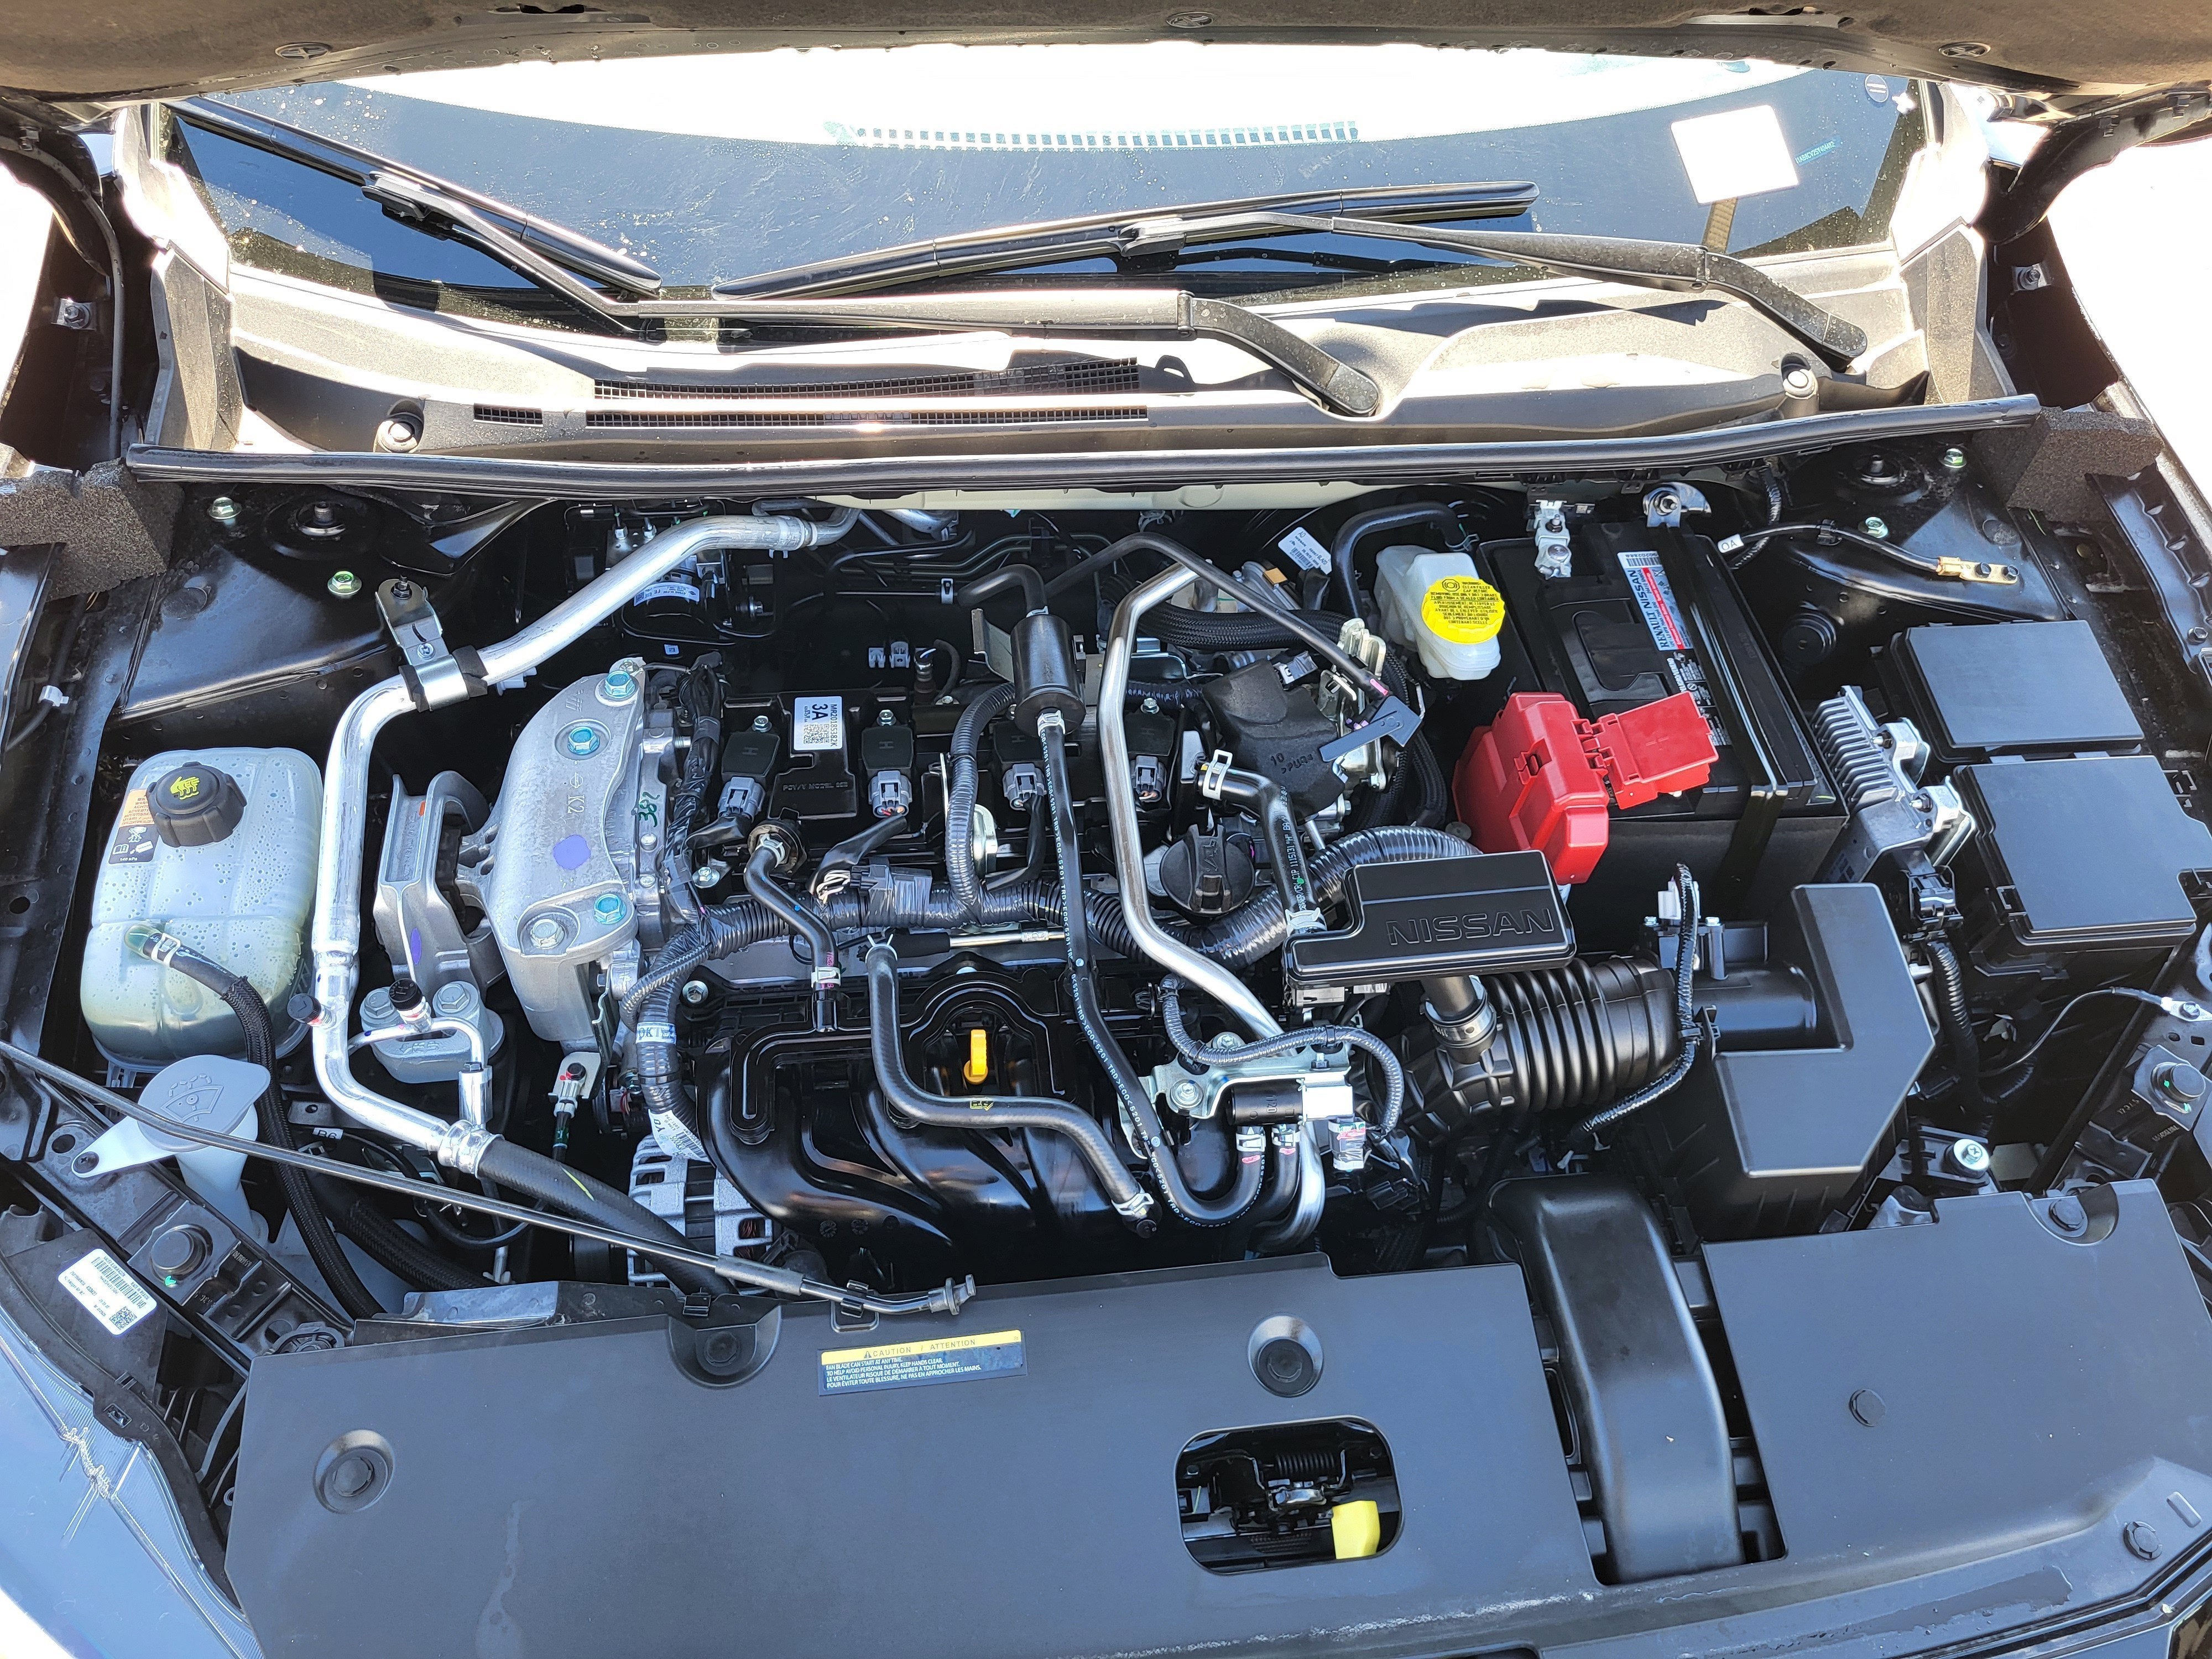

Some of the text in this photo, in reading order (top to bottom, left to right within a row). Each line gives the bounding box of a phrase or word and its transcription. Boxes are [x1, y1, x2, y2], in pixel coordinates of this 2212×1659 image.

[1627, 570, 1652, 609] NISSAN
[812, 703, 828, 720] 3A
[1385, 907, 1554, 946] NISSAN
[873, 1347, 911, 1357] CAUTION
[930, 1339, 975, 1349] ATTENTION
[860, 1364, 883, 1373] PERSONAL
[925, 1368, 954, 1376] APPROCHER
